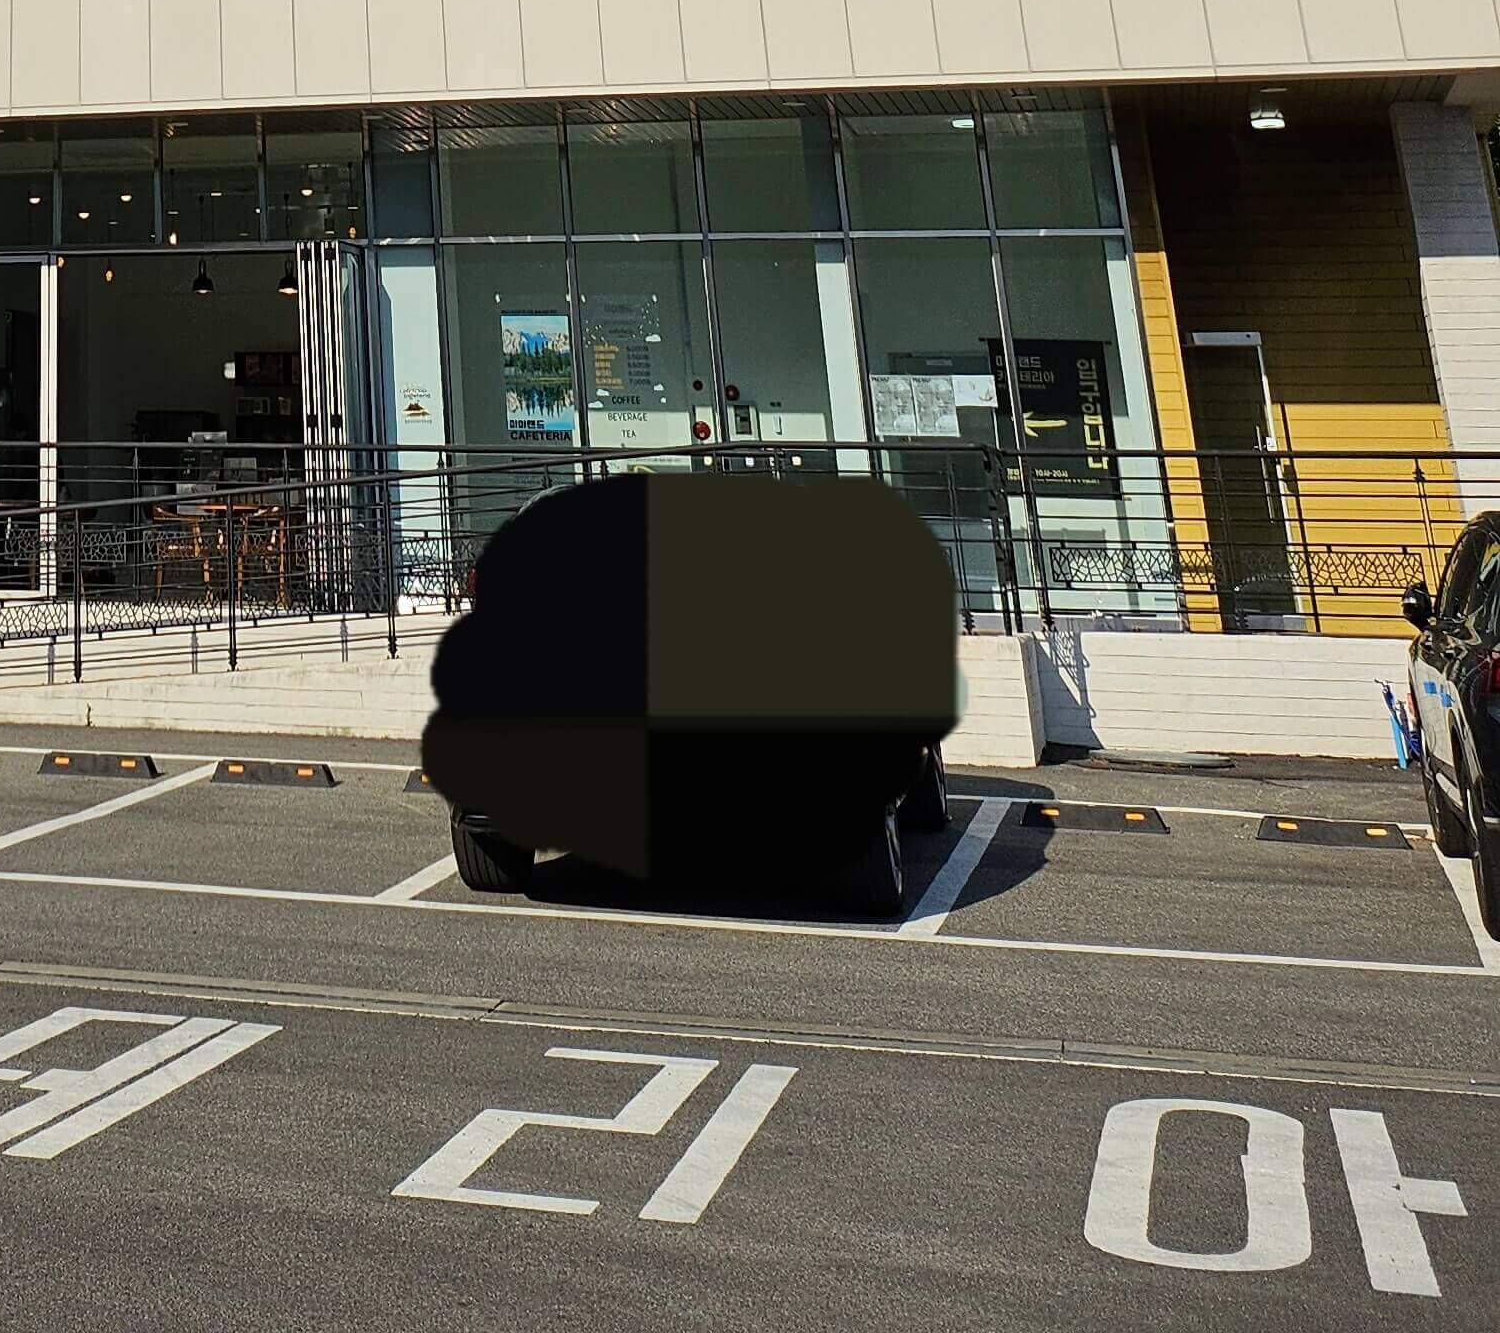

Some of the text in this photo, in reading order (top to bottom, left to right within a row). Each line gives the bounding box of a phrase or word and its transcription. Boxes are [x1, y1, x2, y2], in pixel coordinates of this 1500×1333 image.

[611, 395, 642, 405] COFFEE
[607, 412, 648, 422] BEVERAGE
[510, 430, 572, 441] CAFETERIA
[621, 429, 637, 438] TEA
